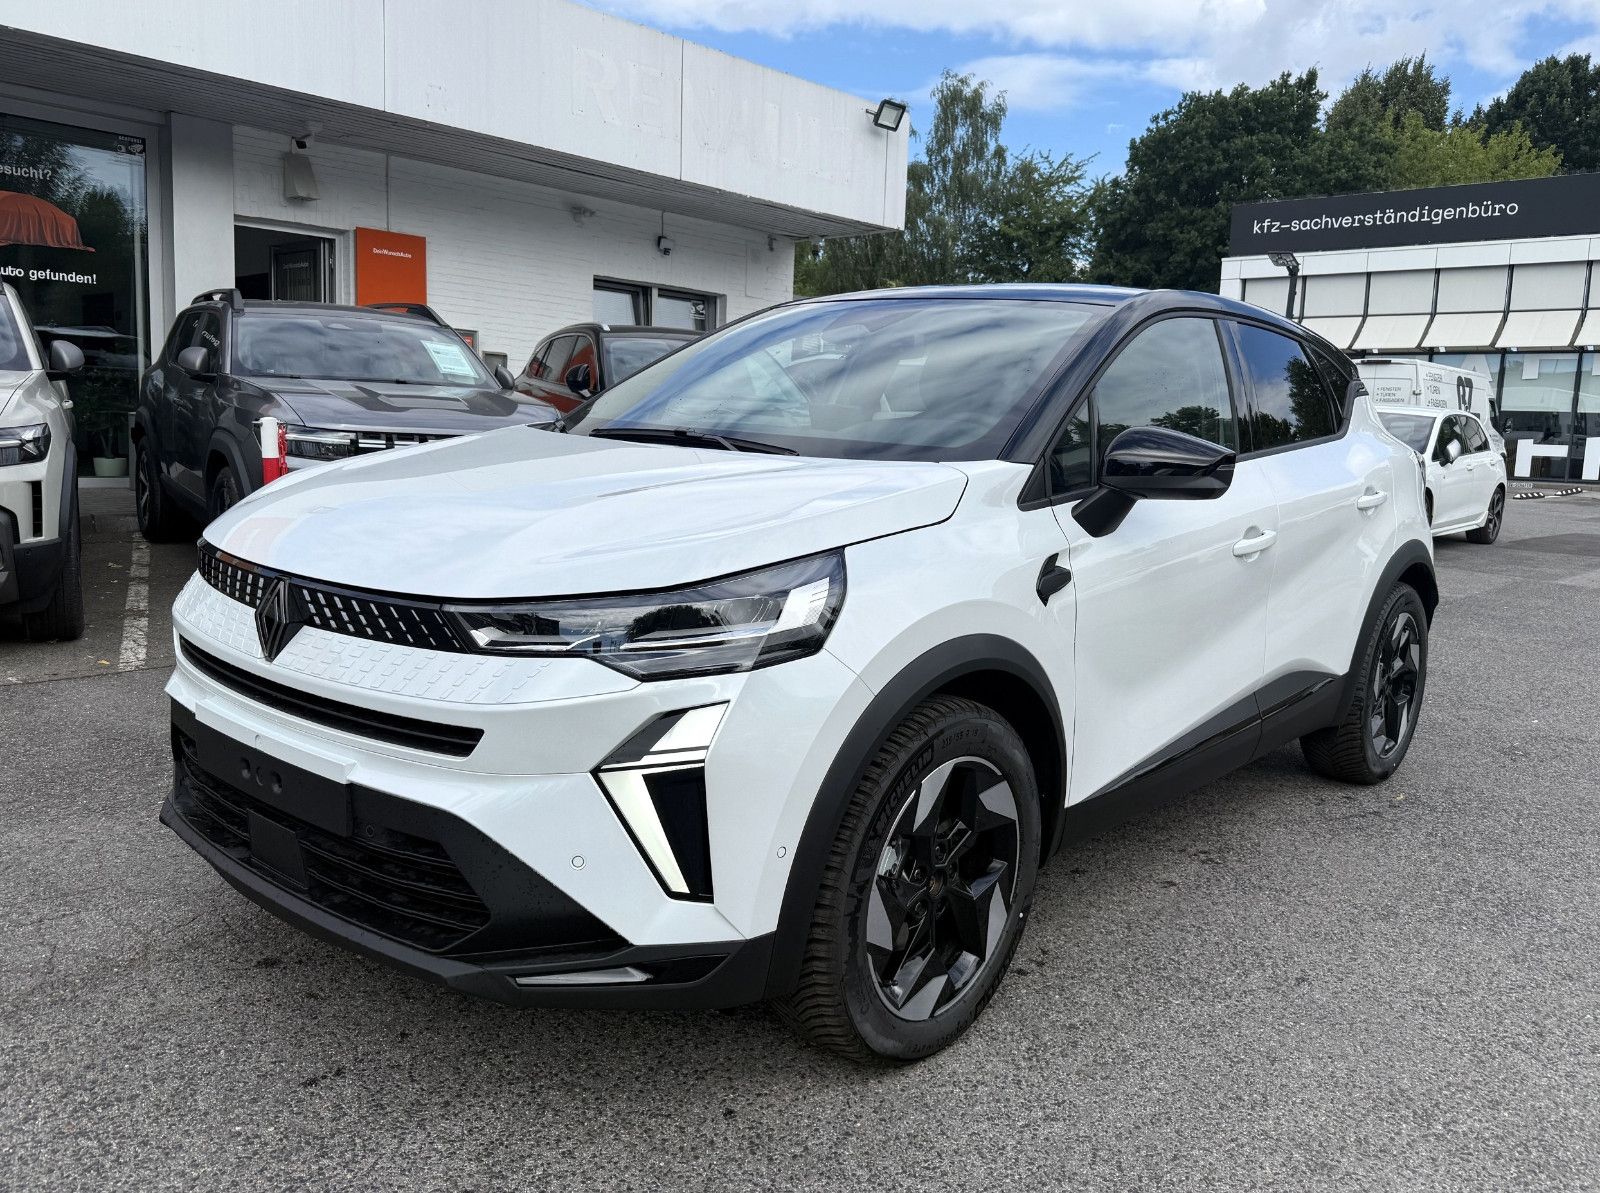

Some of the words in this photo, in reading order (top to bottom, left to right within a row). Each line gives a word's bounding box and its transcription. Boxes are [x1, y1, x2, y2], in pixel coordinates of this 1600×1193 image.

[1253, 200, 1519, 234] kfz-sachverständigenbüro
[0, 265, 24, 278] uto
[28, 268, 97, 285] gefunden!
[875, 744, 934, 836] MICHELIN
